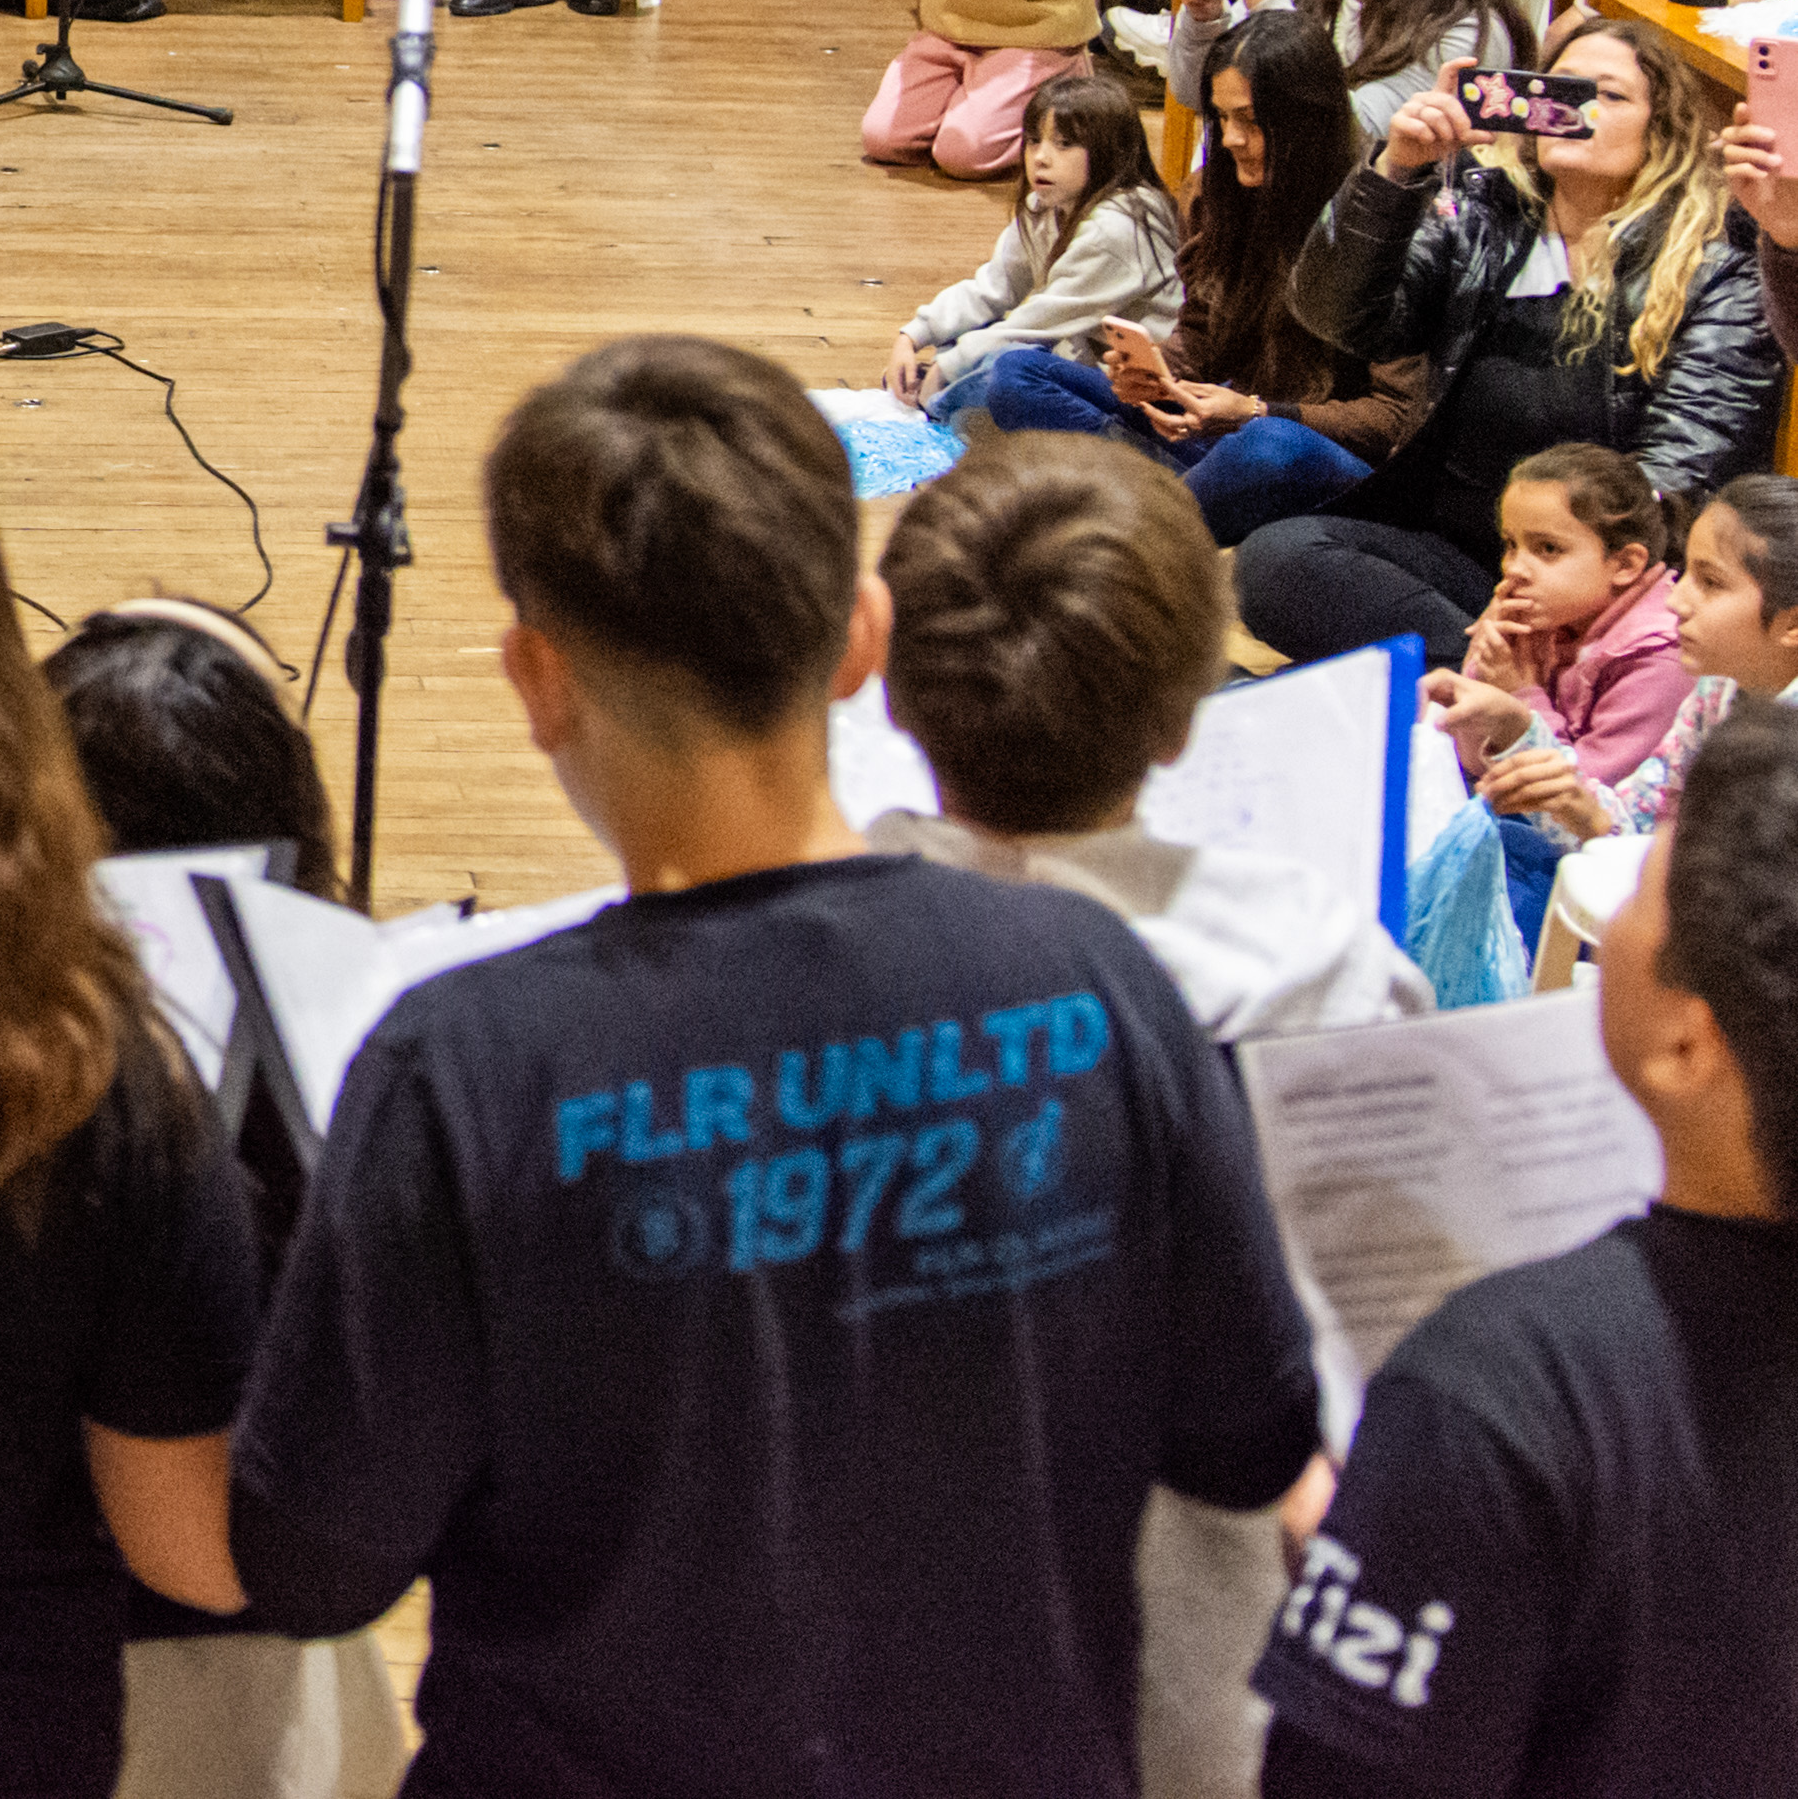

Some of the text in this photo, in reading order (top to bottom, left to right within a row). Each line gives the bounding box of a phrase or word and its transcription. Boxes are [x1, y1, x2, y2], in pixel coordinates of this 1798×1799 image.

[554, 991, 1109, 1183] FLR UNLTD
[726, 1118, 981, 1274] 1972
